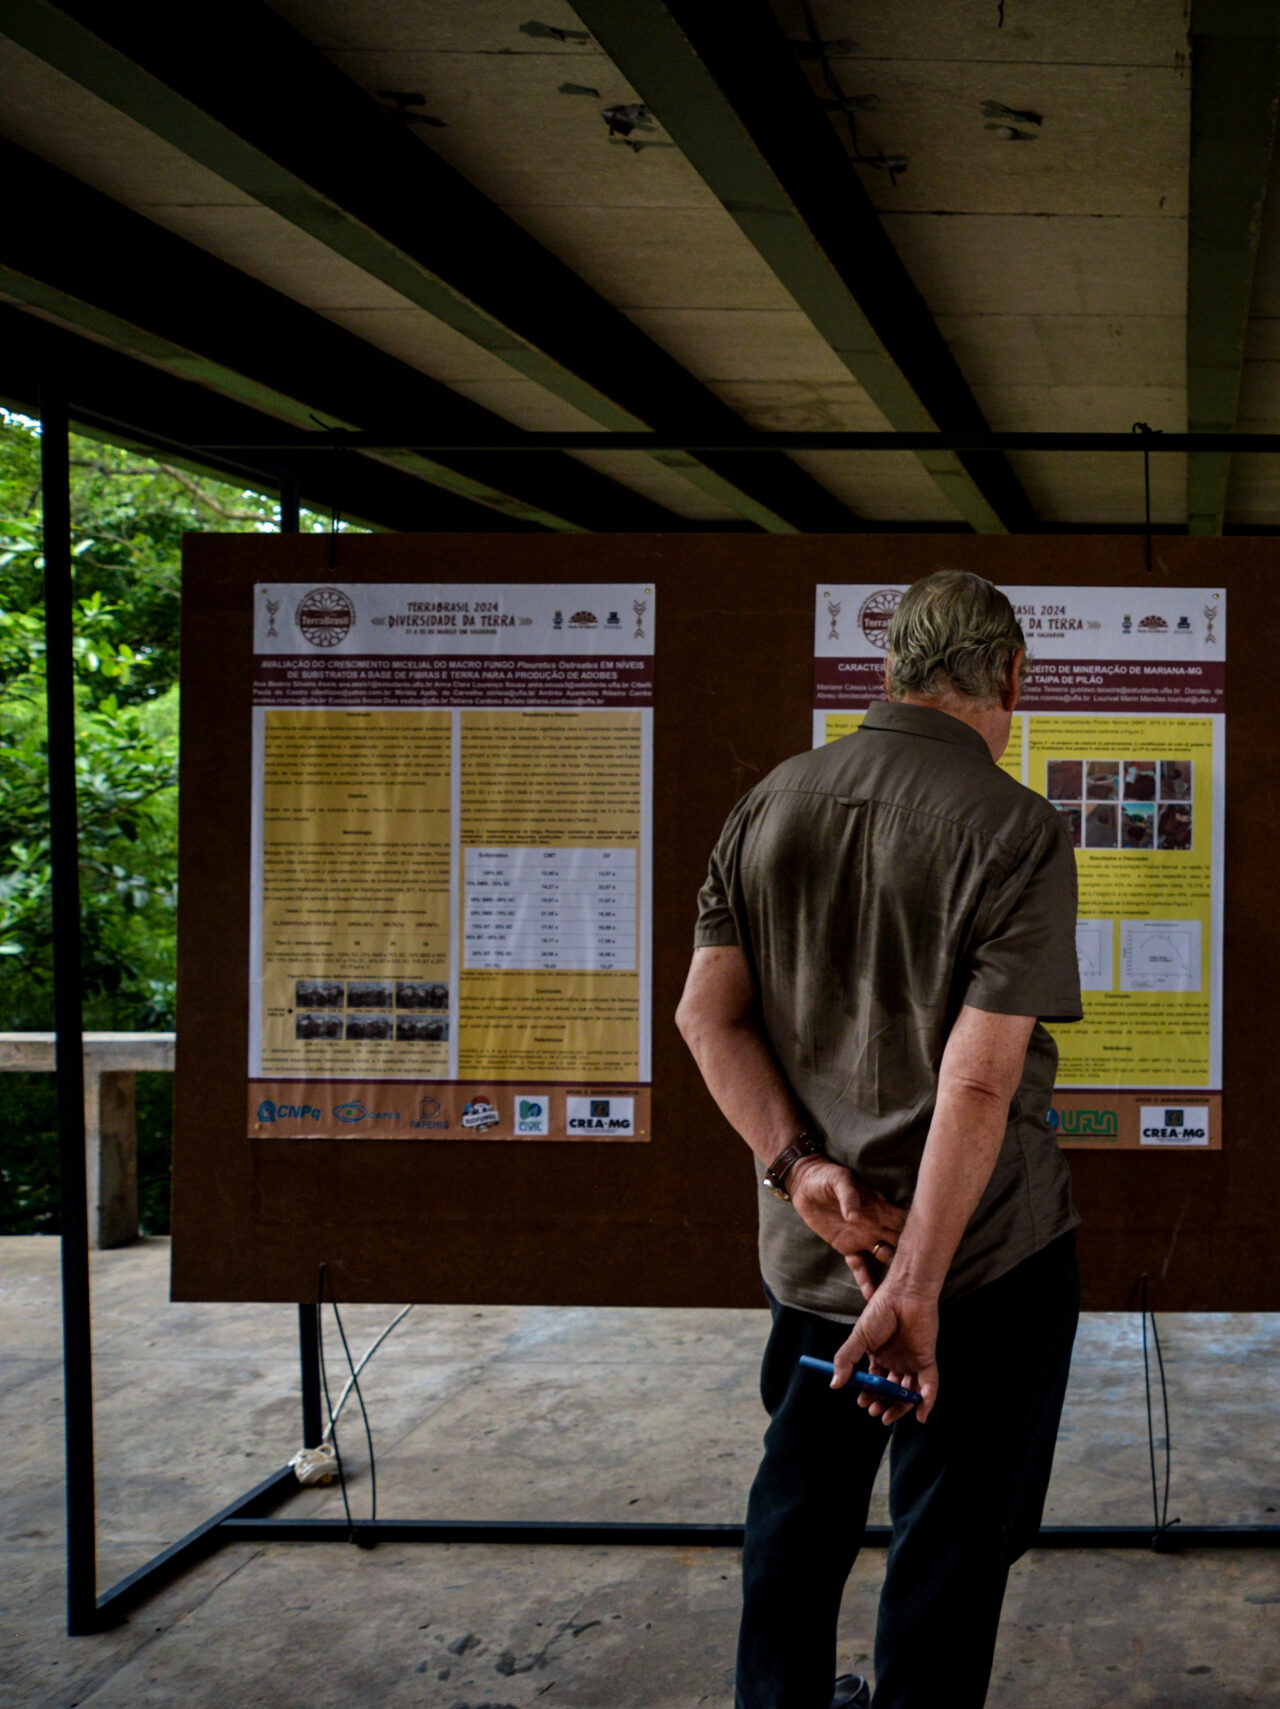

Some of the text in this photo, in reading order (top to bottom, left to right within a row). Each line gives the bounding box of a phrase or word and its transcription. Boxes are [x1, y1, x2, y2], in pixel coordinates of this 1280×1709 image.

[407, 602, 498, 612] TERRABRASIL 2024
[1040, 605, 1066, 615] 2024
[302, 617, 349, 626] TerraBrasil
[388, 615, 515, 628] DIVERSIDADE DA TERRA
[1029, 618, 1083, 630] DA TERRA
[261, 659, 310, 670] AVALIAÇÃO
[312, 660, 325, 669] DO
[327, 660, 390, 669] CRESCIMENTO
[392, 660, 431, 669] MICELIAL
[434, 660, 447, 669] DO
[451, 661, 481, 669] MACRO
[484, 661, 515, 669] FUNGO
[600, 661, 614, 669] EM
[616, 659, 645, 669] NÍVEIS
[838, 663, 886, 672] CARACTER
[1058, 665, 1071, 674] DE
[1072, 664, 1127, 676] MINERAÇÃO
[1129, 666, 1142, 674] DE
[1143, 666, 1203, 675] MARIANA-MG
[287, 670, 299, 679] DE
[301, 670, 359, 679] SUBSTRATOS
[359, 670, 366, 679] A
[368, 670, 392, 679] BASE
[394, 670, 407, 679] DE
[409, 670, 440, 679] FIBRAS
[450, 671, 480, 679] TERRA
[482, 671, 505, 679] PARA
[515, 670, 564, 680] PRODUÇÃO
[567, 671, 579, 679] DE
[581, 671, 618, 679] ADOBES
[1035, 676, 1060, 684] TAIPA
[1061, 676, 1074, 684] DE
[1076, 674, 1104, 685] PILÃO
[278, 1103, 321, 1121] CNPq
